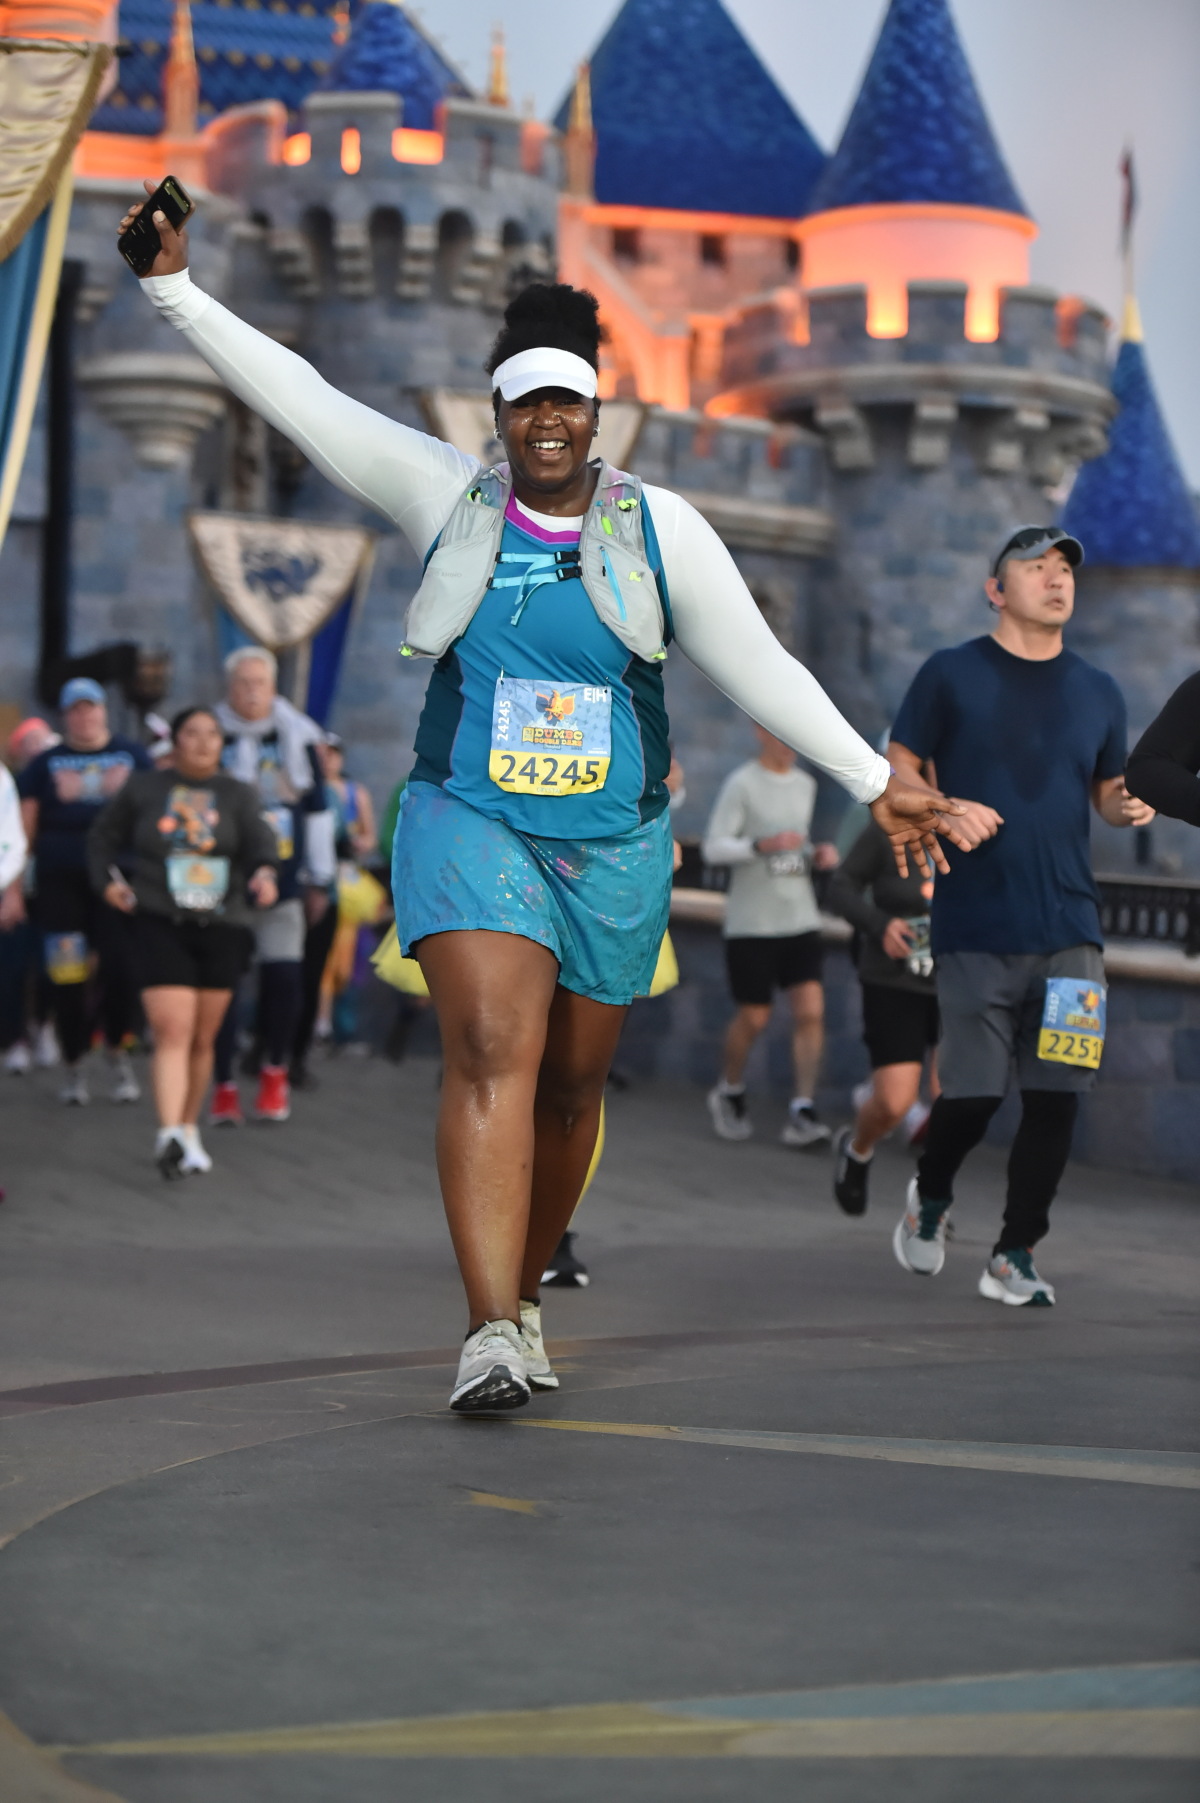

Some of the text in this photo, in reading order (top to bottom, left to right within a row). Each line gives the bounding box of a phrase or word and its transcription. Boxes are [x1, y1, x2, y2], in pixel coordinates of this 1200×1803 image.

[497, 700, 511, 741] 24245
[534, 728, 583, 741] DUMBO
[499, 754, 600, 786] 24245
[1047, 1033, 1103, 1060] 2251
